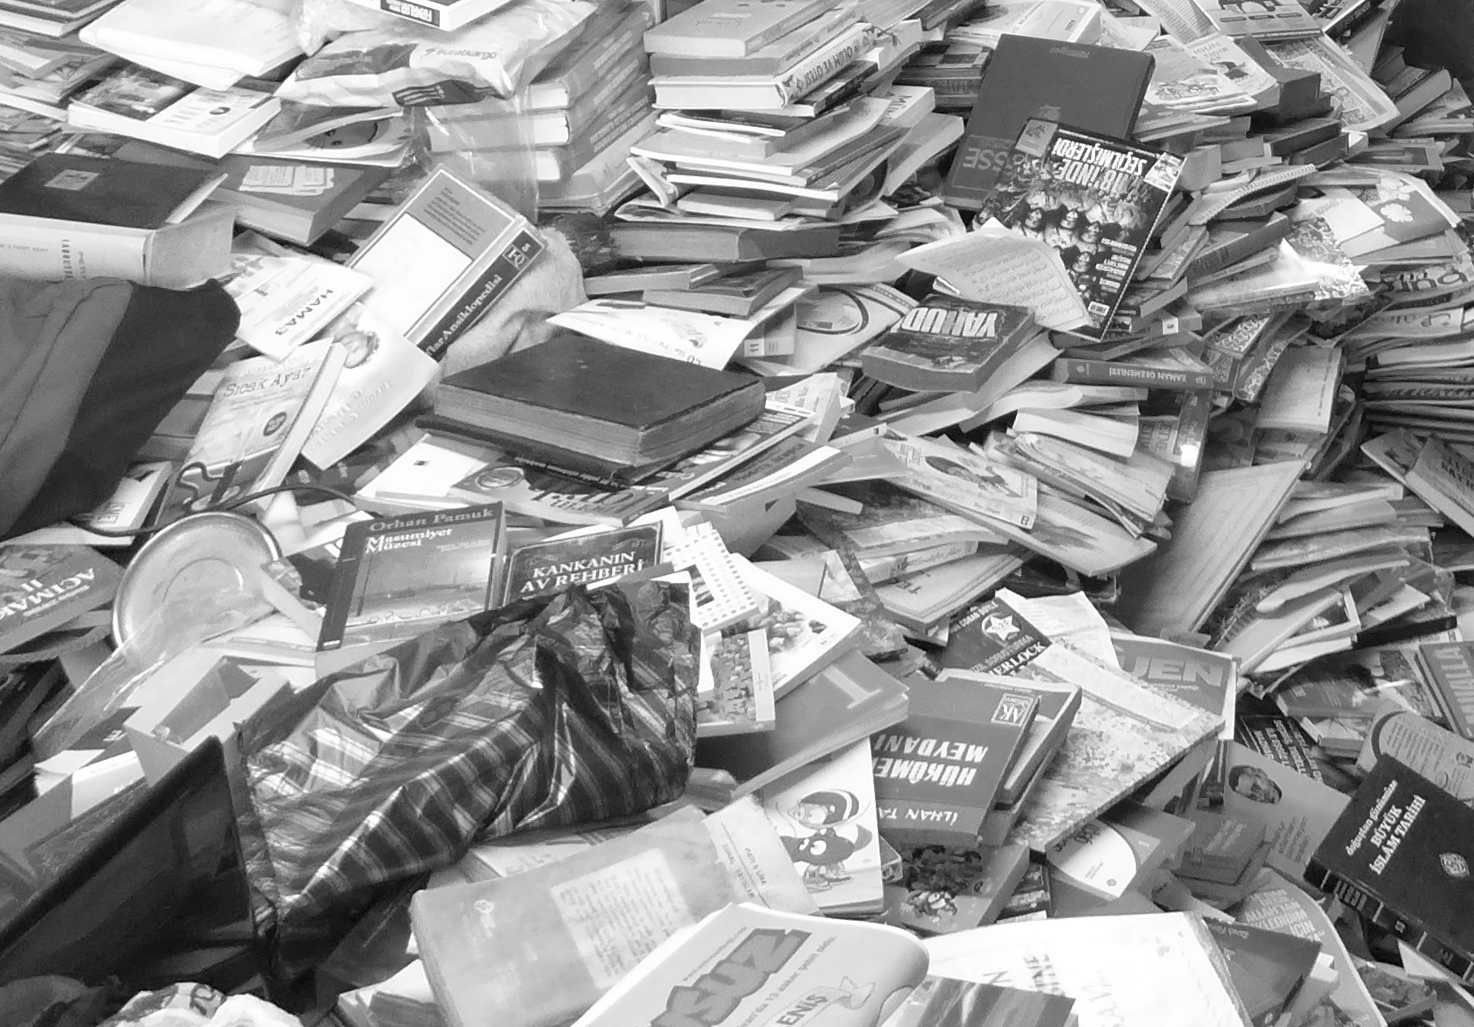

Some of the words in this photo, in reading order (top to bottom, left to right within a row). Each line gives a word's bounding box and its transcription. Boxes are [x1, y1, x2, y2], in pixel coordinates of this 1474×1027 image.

[441, 274, 503, 340] Ansiklopedisi
[223, 377, 267, 397] Sıcak
[1157, 370, 1187, 382] ZAMAN
[370, 517, 427, 531] Orhan
[433, 507, 492, 524] Pamuk
[365, 539, 422, 553] Müzesi
[366, 528, 453, 544] Masumiyet
[521, 578, 552, 593] AV
[555, 558, 643, 585] REHBERİ
[533, 552, 634, 578] KANKANIN
[873, 733, 988, 763] MEYDANI
[904, 808, 958, 826] İLHAN
[1370, 804, 1402, 848] BÜYÜK
[1368, 834, 1401, 875] İSLAM
[1394, 794, 1426, 838] TARİHİ
